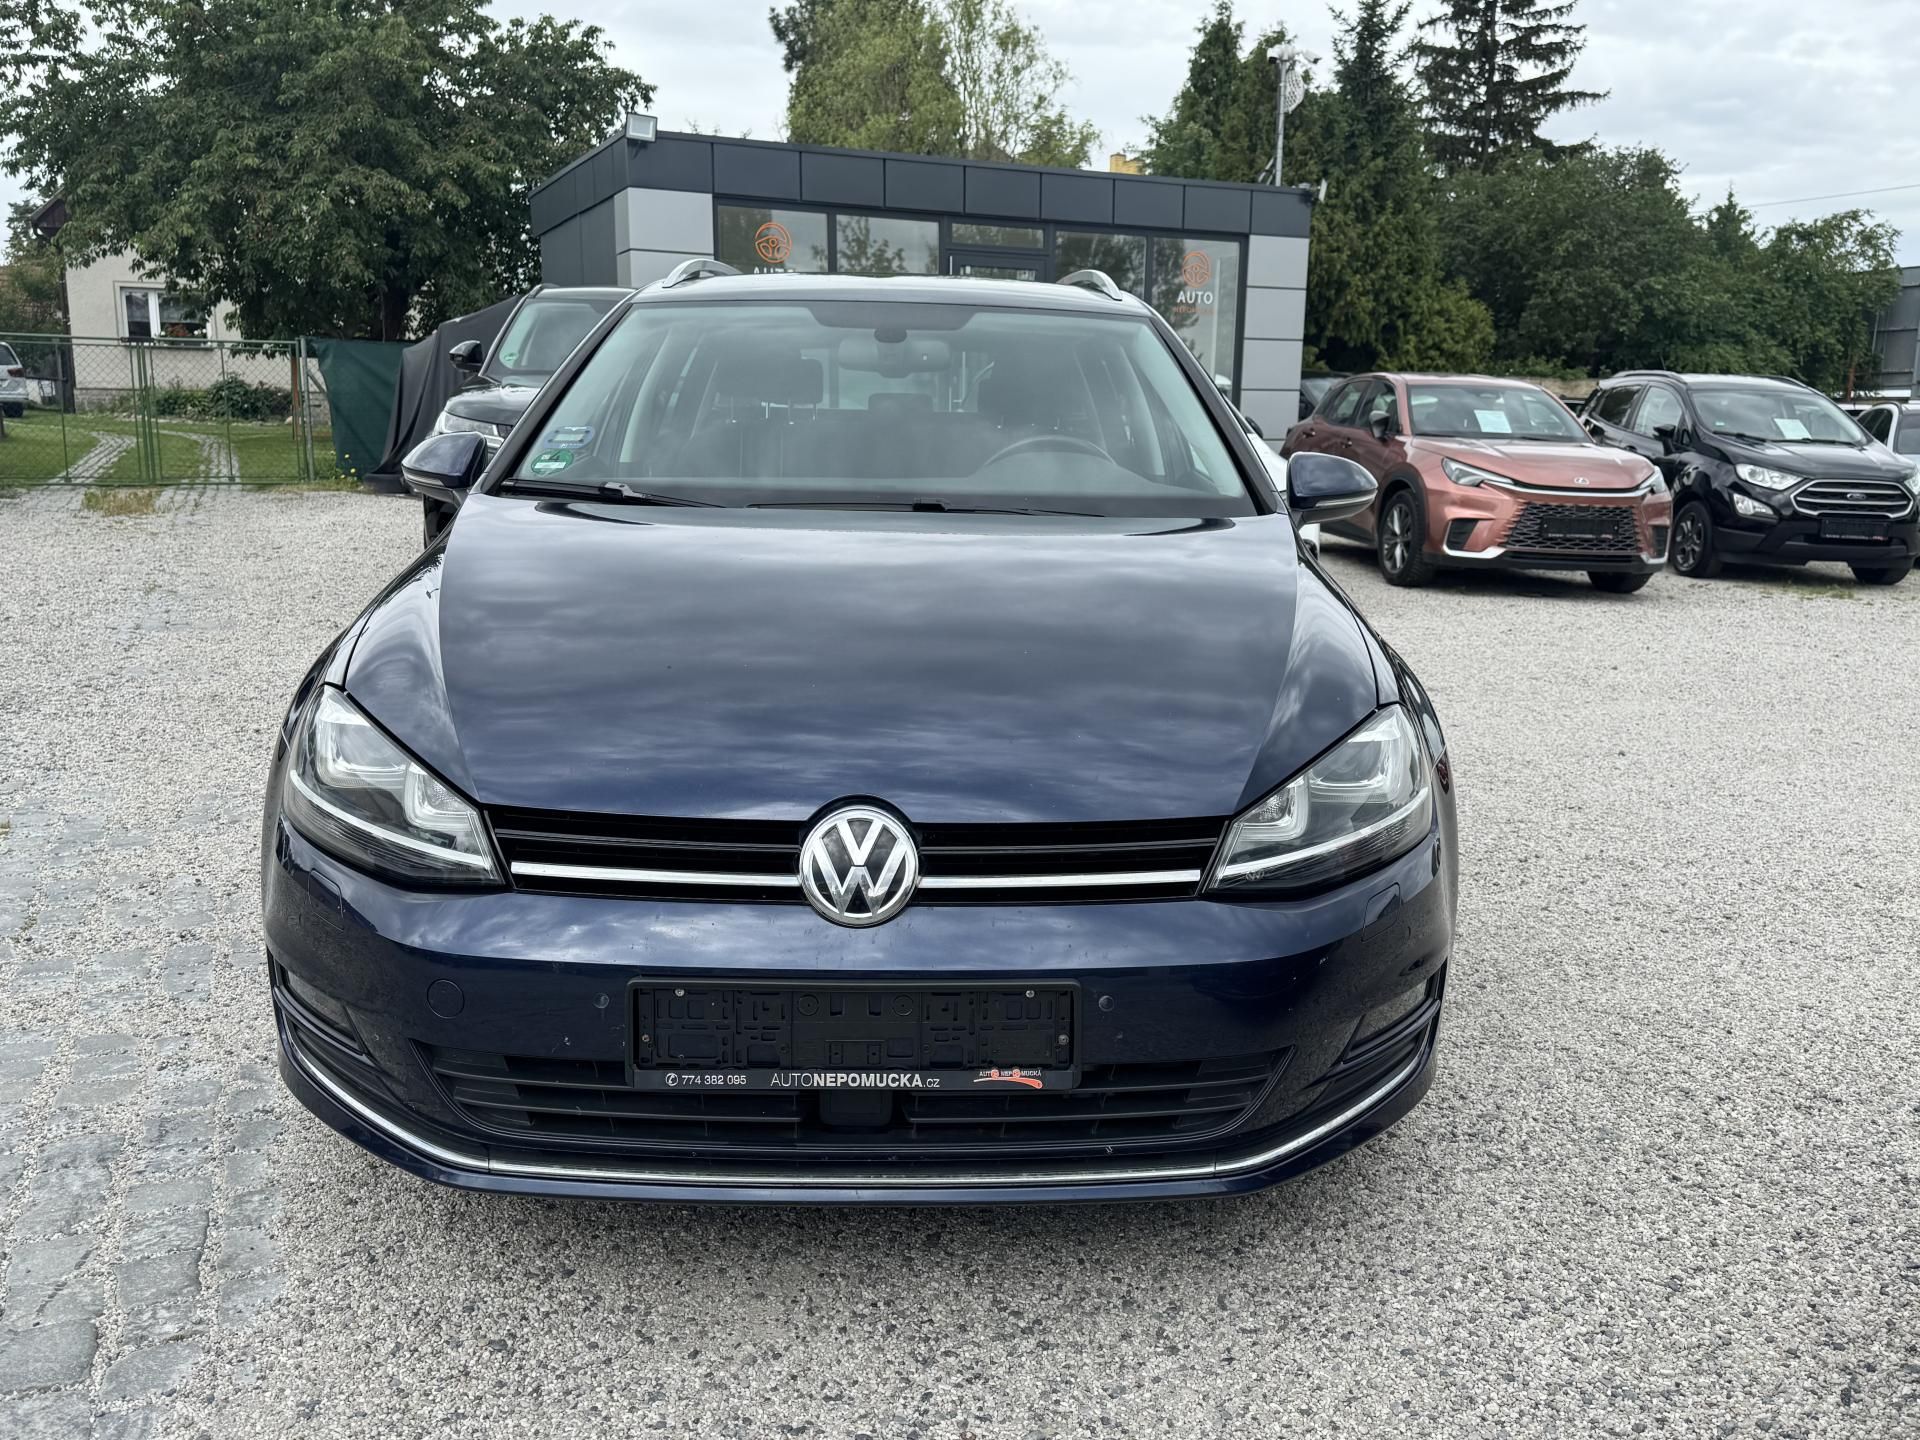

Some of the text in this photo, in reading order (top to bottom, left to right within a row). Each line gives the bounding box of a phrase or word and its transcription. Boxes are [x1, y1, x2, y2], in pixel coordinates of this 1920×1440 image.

[1177, 290, 1213, 304] AUTO
[682, 1075, 747, 1085] 774 382 095
[770, 1073, 940, 1087] AUTONEPOMUCKA.cz
